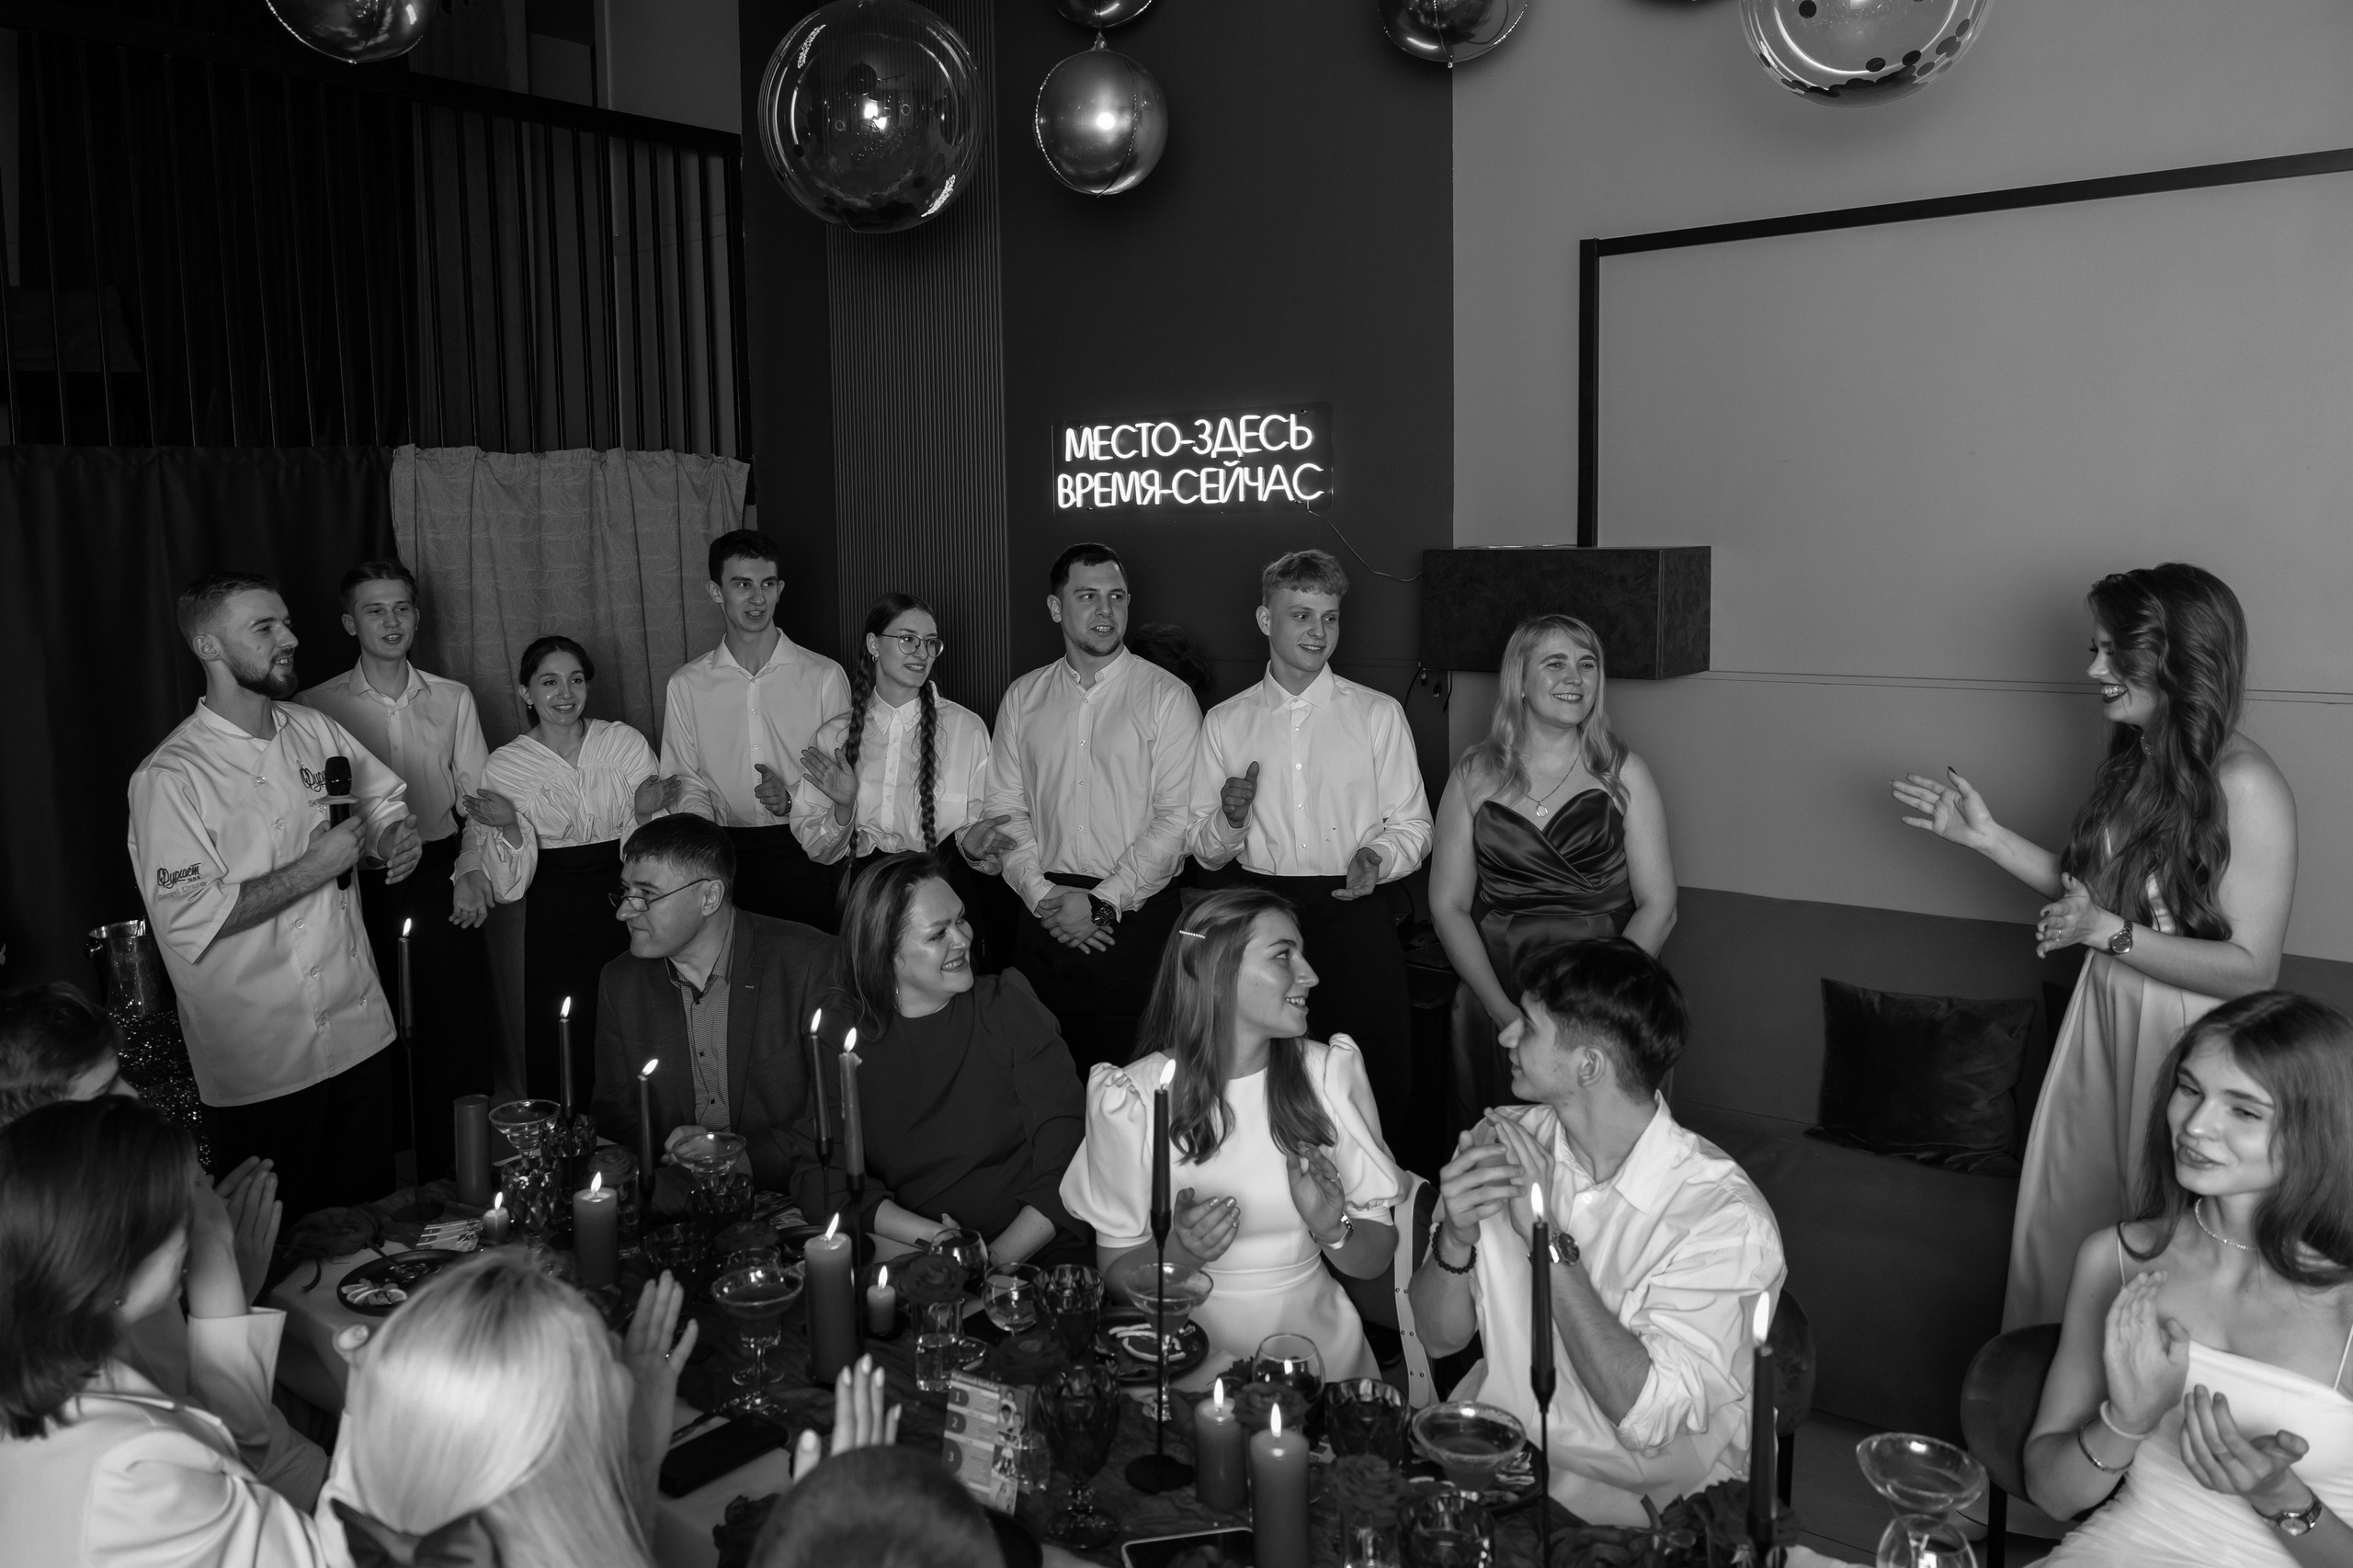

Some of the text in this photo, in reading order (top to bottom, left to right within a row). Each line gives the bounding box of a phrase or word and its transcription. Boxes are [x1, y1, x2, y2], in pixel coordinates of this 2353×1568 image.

[1064, 414, 1315, 462] МЕСТО-ЗДЕСЬ
[1057, 460, 1324, 509] ВРЕМЯ-СЕЙЧАС
[951, 1417, 959, 1428] 2
